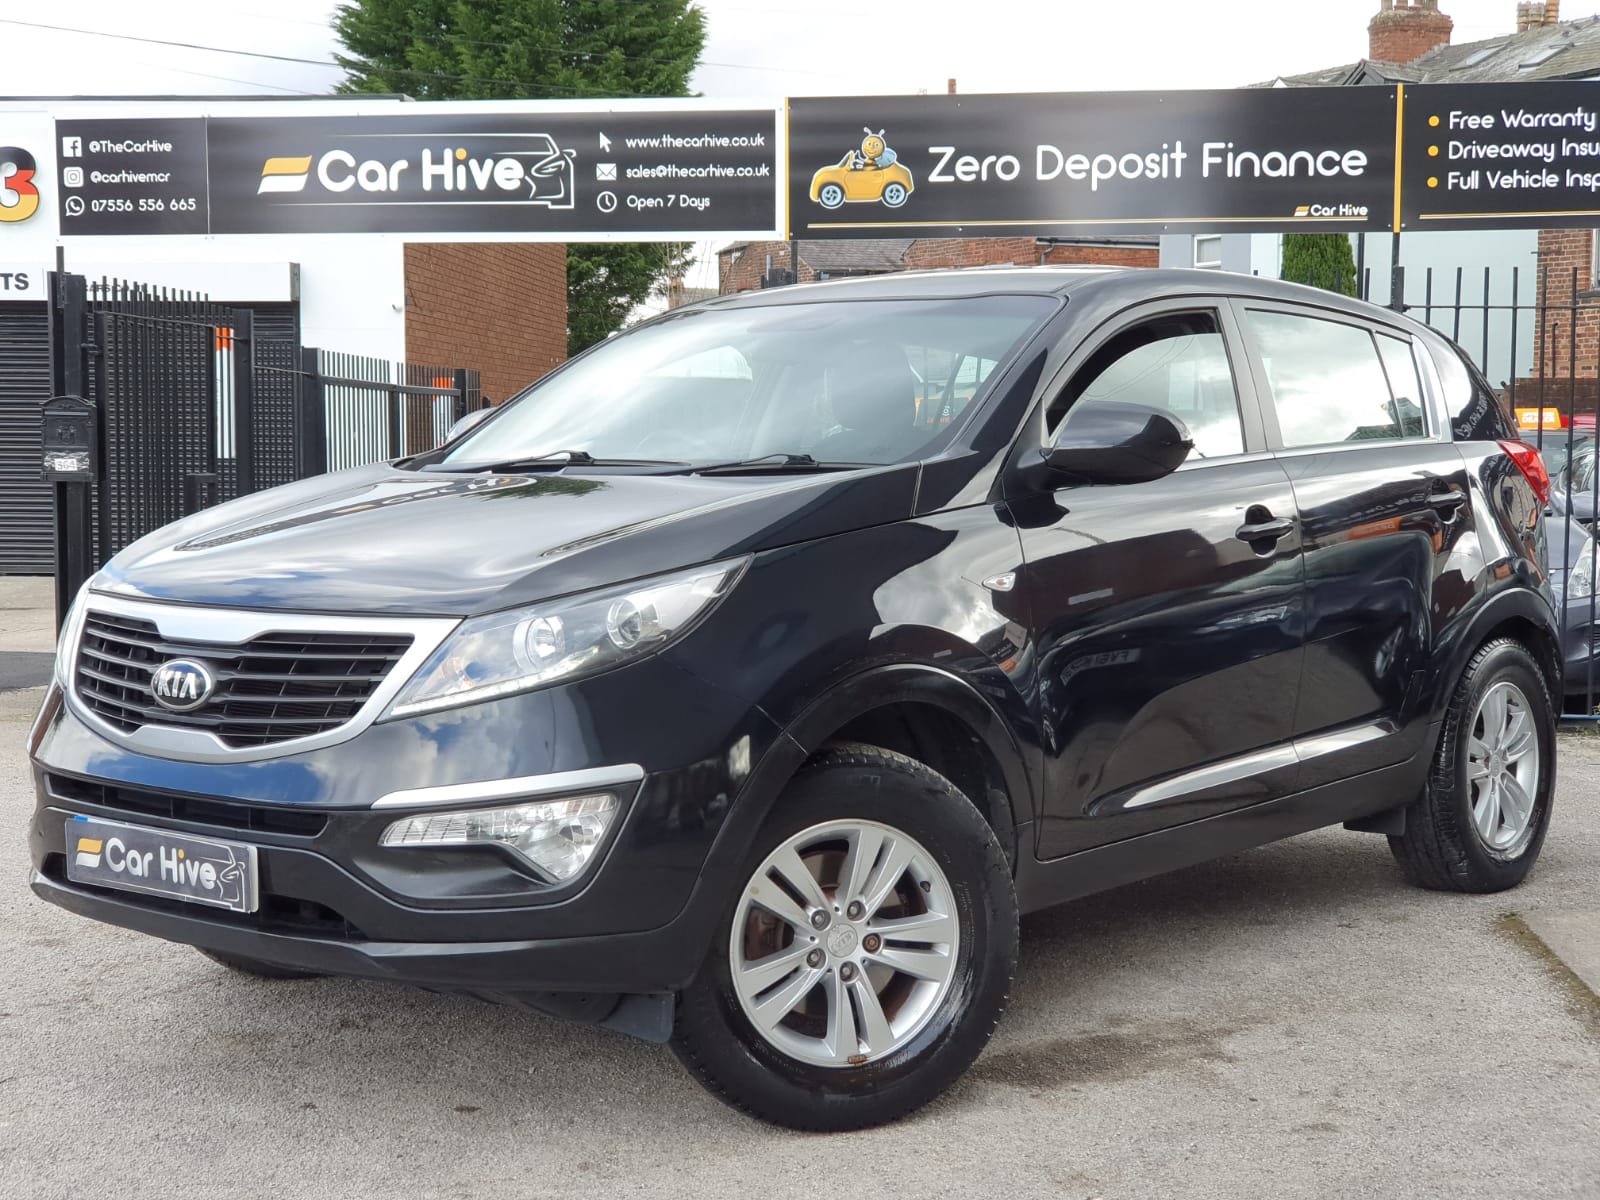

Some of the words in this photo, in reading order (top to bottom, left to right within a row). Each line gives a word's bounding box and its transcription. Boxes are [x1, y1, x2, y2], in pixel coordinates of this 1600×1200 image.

[1449, 110, 1495, 130] Free
[1500, 106, 1596, 132] Warranty
[88, 139, 173, 153] @TheCarHive
[625, 132, 766, 148] www.thecarhive.co.uk
[1448, 140, 1555, 163] Driveaway
[317, 149, 409, 193] Car
[421, 147, 525, 192] Hive
[625, 163, 770, 178] sales@thecarhive.co.uk
[927, 146, 1021, 183] Zero
[1036, 140, 1188, 192] Deposit
[1202, 141, 1368, 178] Finance
[90, 169, 171, 184] @carhivemcr
[1447, 170, 1480, 190] Full
[1486, 168, 1560, 189] Vehicle
[91, 199, 134, 212] 07556
[138, 198, 165, 212] 556
[169, 198, 197, 212] 665
[626, 194, 664, 211] Open
[667, 194, 676, 207] 7
[679, 194, 711, 211] Days
[1310, 204, 1336, 216] Car
[1339, 203, 1368, 216] Hive
[157, 669, 198, 700] KIA
[104, 837, 154, 877] Car
[159, 846, 218, 890] Hive
